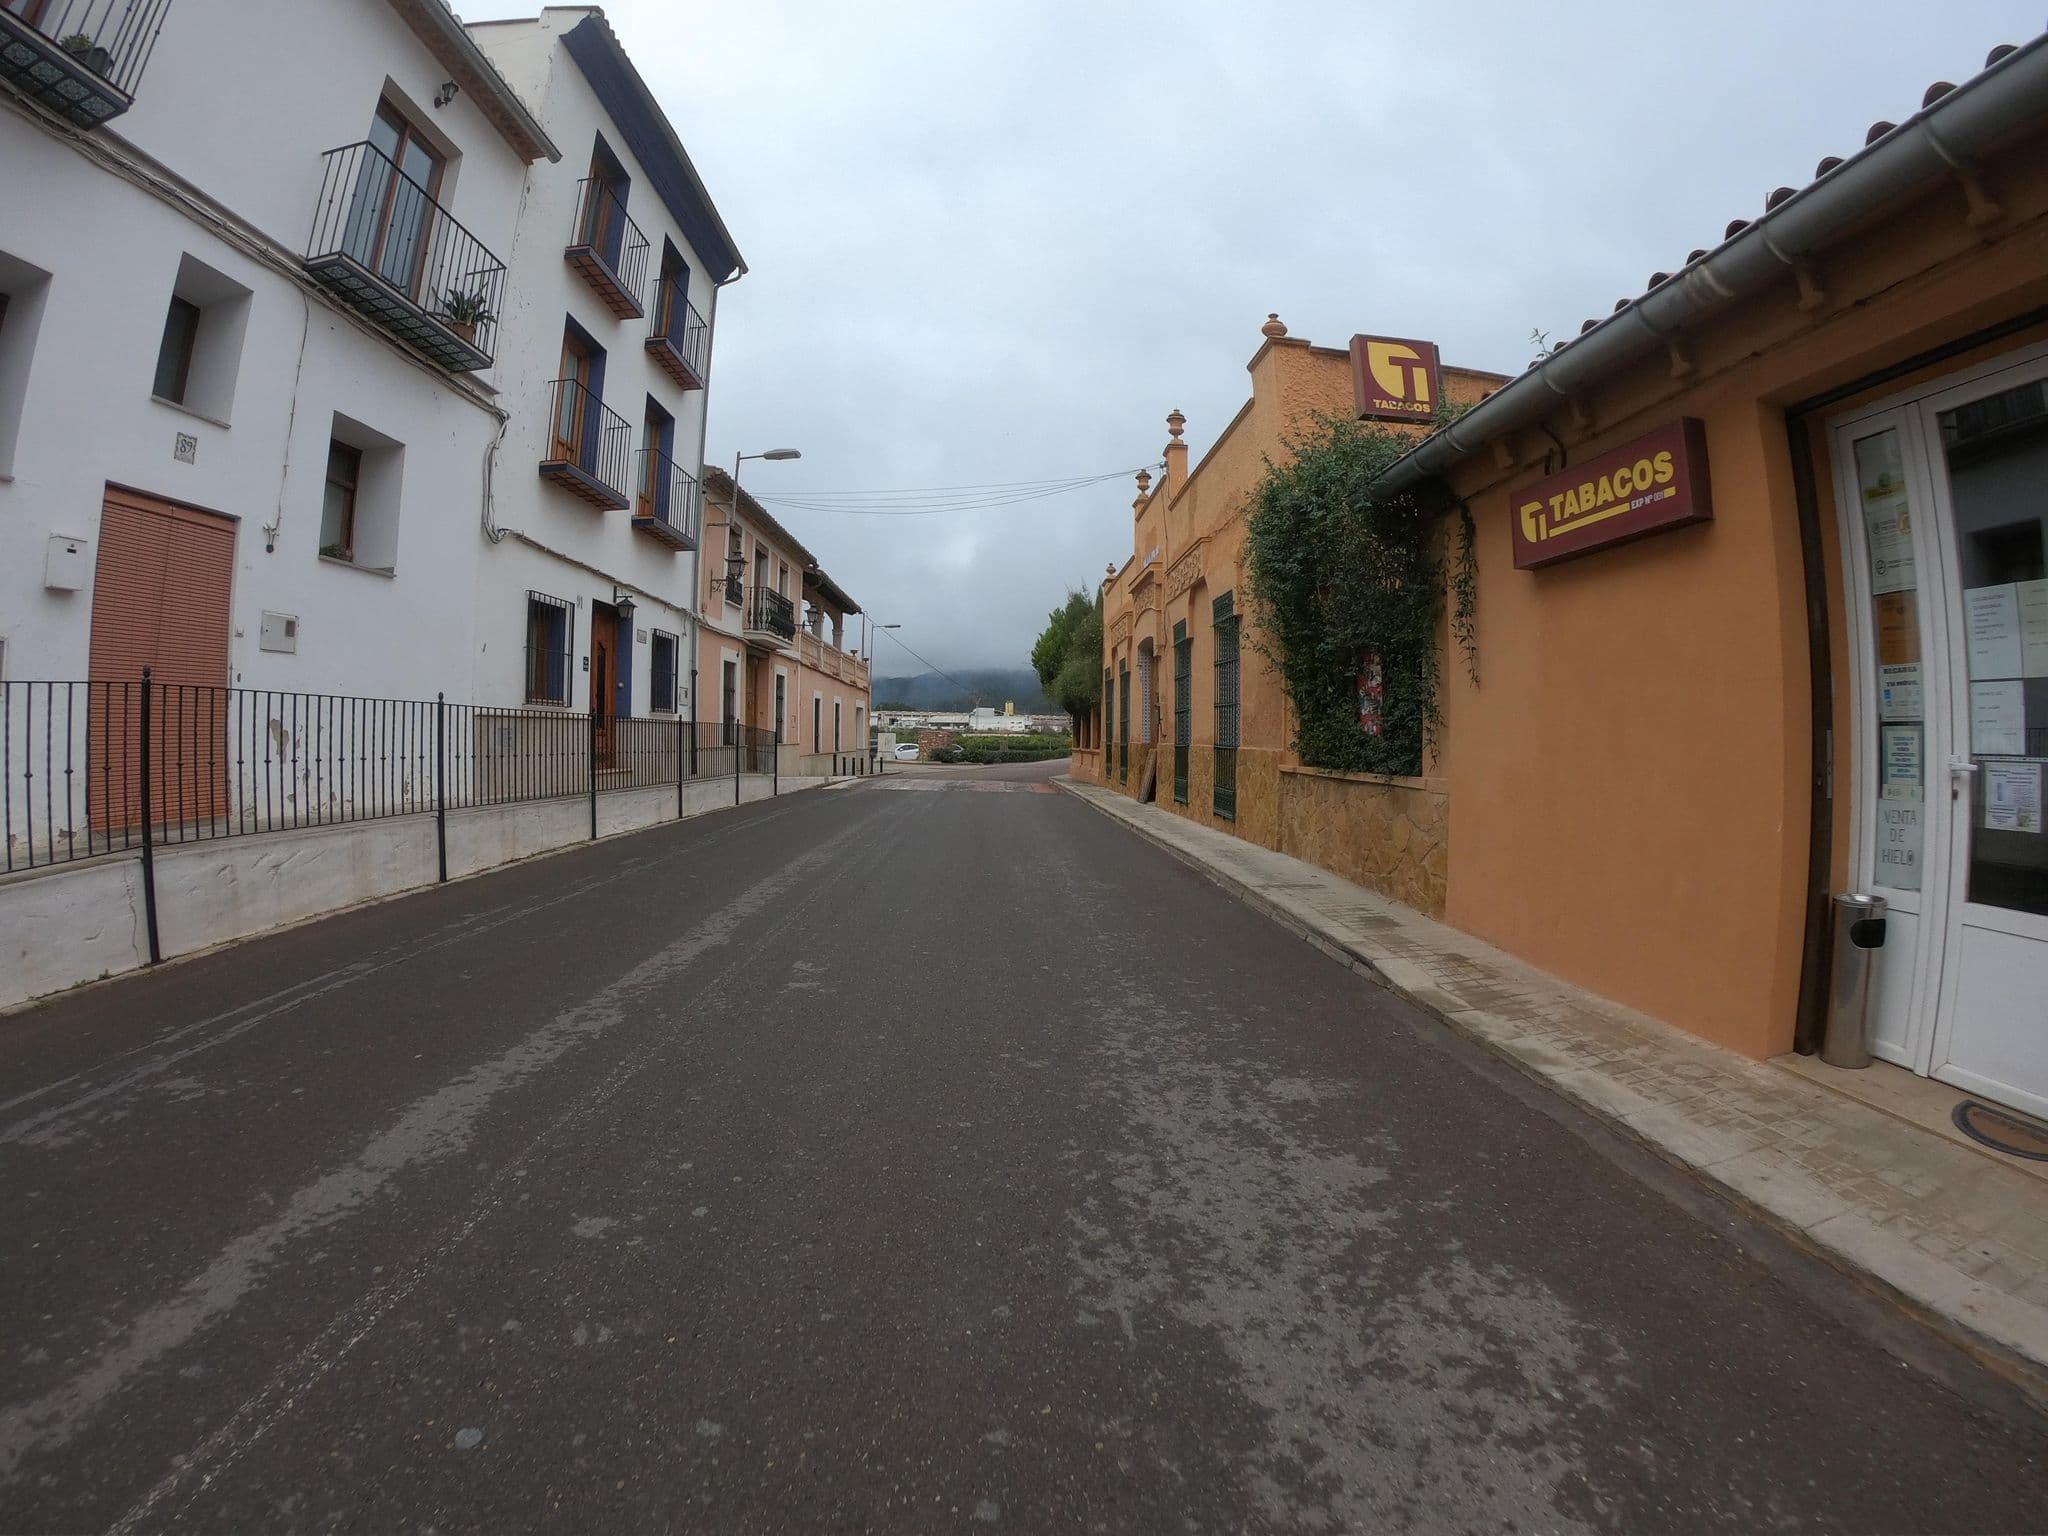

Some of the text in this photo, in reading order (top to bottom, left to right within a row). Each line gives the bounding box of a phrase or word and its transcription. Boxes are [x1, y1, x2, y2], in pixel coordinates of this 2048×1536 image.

[1373, 399, 1431, 413] TABACOS
[180, 438, 193, 454] 89
[1550, 451, 1674, 522] TABACOS
[1884, 810, 1917, 825] VENTA
[1889, 828, 1905, 842] DE
